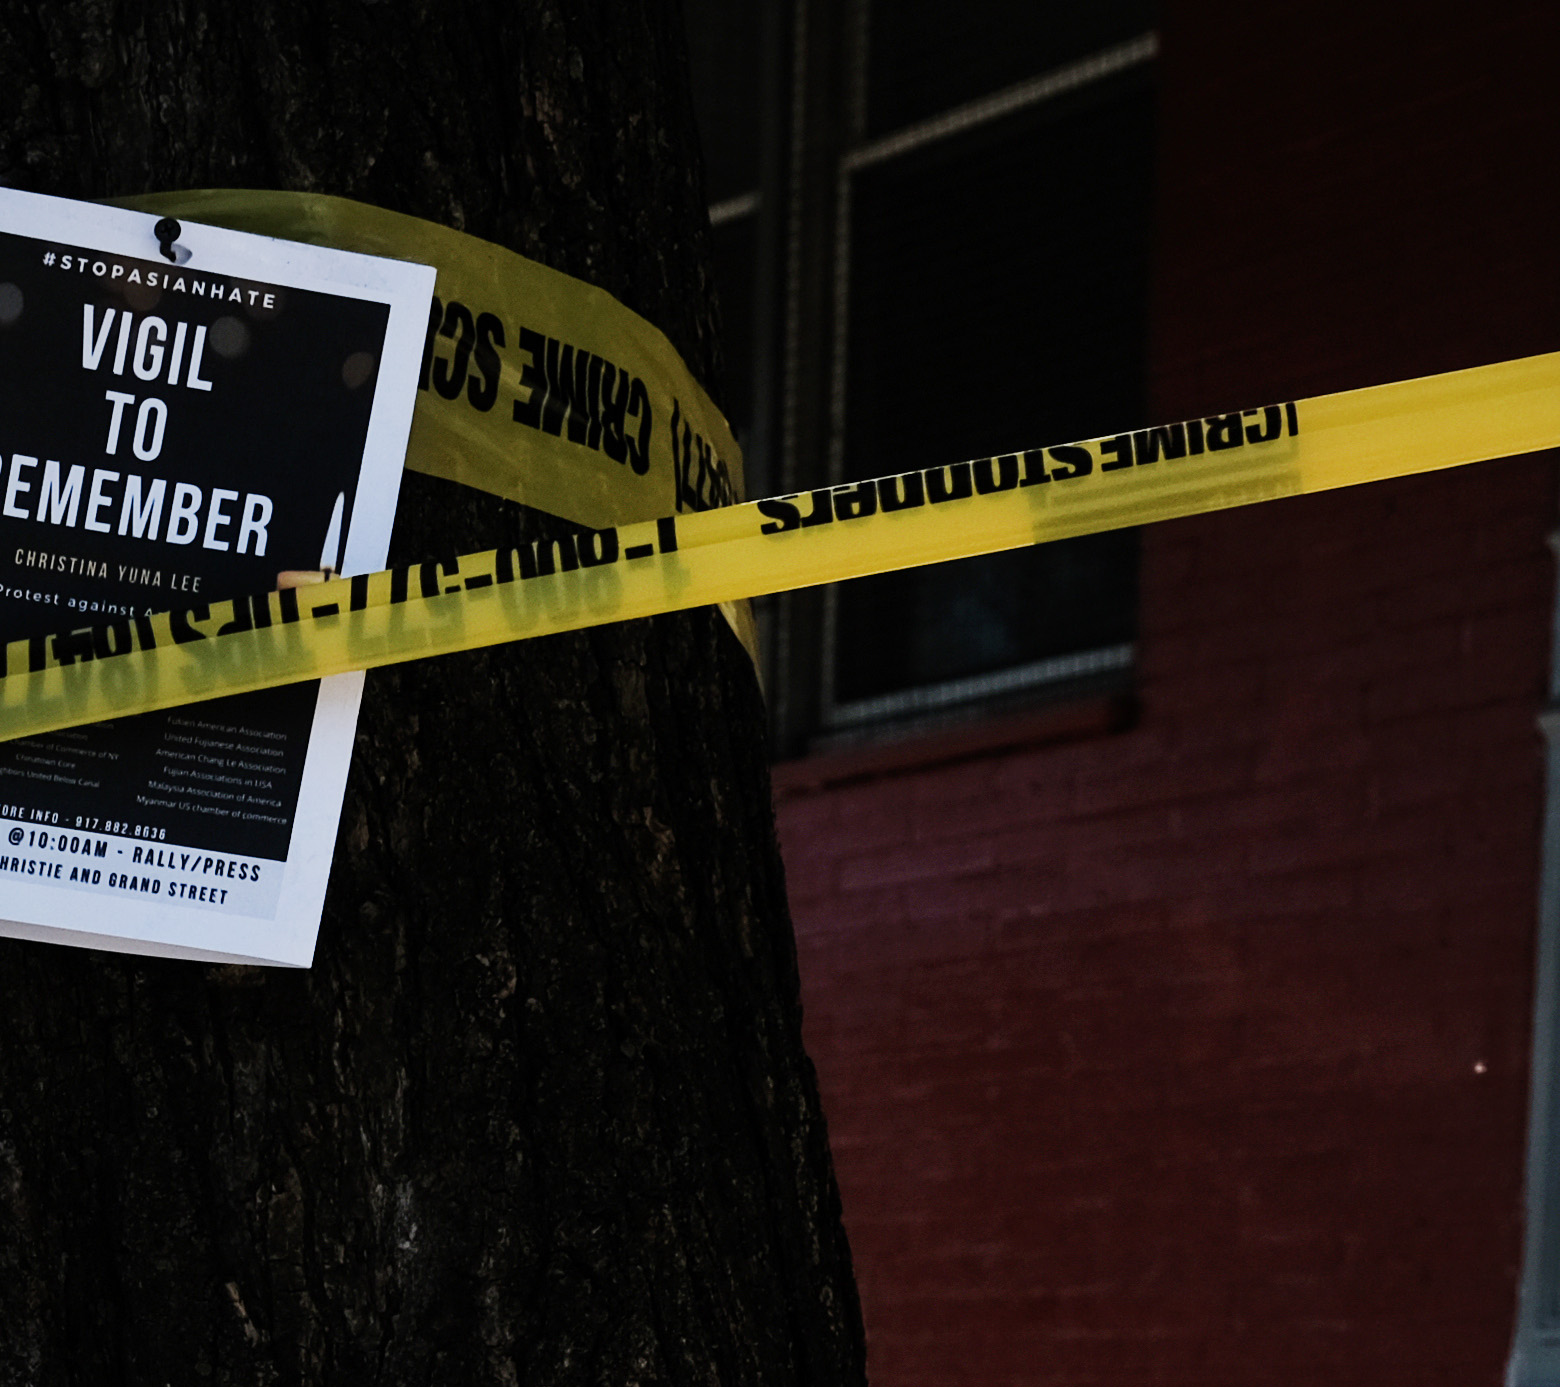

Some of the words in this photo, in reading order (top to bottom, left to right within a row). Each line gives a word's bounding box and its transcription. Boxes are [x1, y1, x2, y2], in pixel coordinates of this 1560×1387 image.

[43, 252, 275, 309] #STOPASIANHATE
[82, 303, 213, 391] VIGIL
[513, 327, 652, 475] CRIME
[105, 390, 168, 462] TO
[14, 548, 108, 579] CHRISTINA
[118, 565, 161, 587] YUNA
[170, 573, 202, 593] LEE
[67, 597, 135, 617] against
[198, 721, 237, 733] American
[239, 726, 287, 741] Association
[98, 751, 107, 759] of
[164, 732, 192, 744] United
[194, 738, 234, 749] Fujianese
[236, 743, 284, 757] Association
[58, 760, 76, 769] Core
[155, 749, 196, 761] American
[197, 755, 224, 767] Chang
[227, 757, 237, 766] Le
[238, 758, 286, 774] Association
[27, 770, 52, 782] United
[54, 774, 76, 785] Below
[78, 778, 100, 788] Canal
[164, 766, 189, 777] Fujian
[190, 770, 242, 785] Associations
[245, 779, 252, 787] in
[255, 779, 273, 789] USA
[148, 780, 184, 793] Malaysia
[186, 786, 234, 800] Association
[236, 794, 245, 802] of
[247, 795, 282, 807] America
[30, 808, 59, 824] INFO
[136, 795, 176, 806] Myanmar
[179, 801, 191, 811] US
[192, 804, 230, 816] chamber
[232, 810, 240, 818] of
[242, 813, 287, 825] commerce
[8, 827, 108, 858] @10:00AM
[132, 846, 261, 882] RALLY/PRESS
[70, 867, 101, 885] AND
[108, 873, 161, 894] GRAND
[168, 882, 228, 905] STREET
